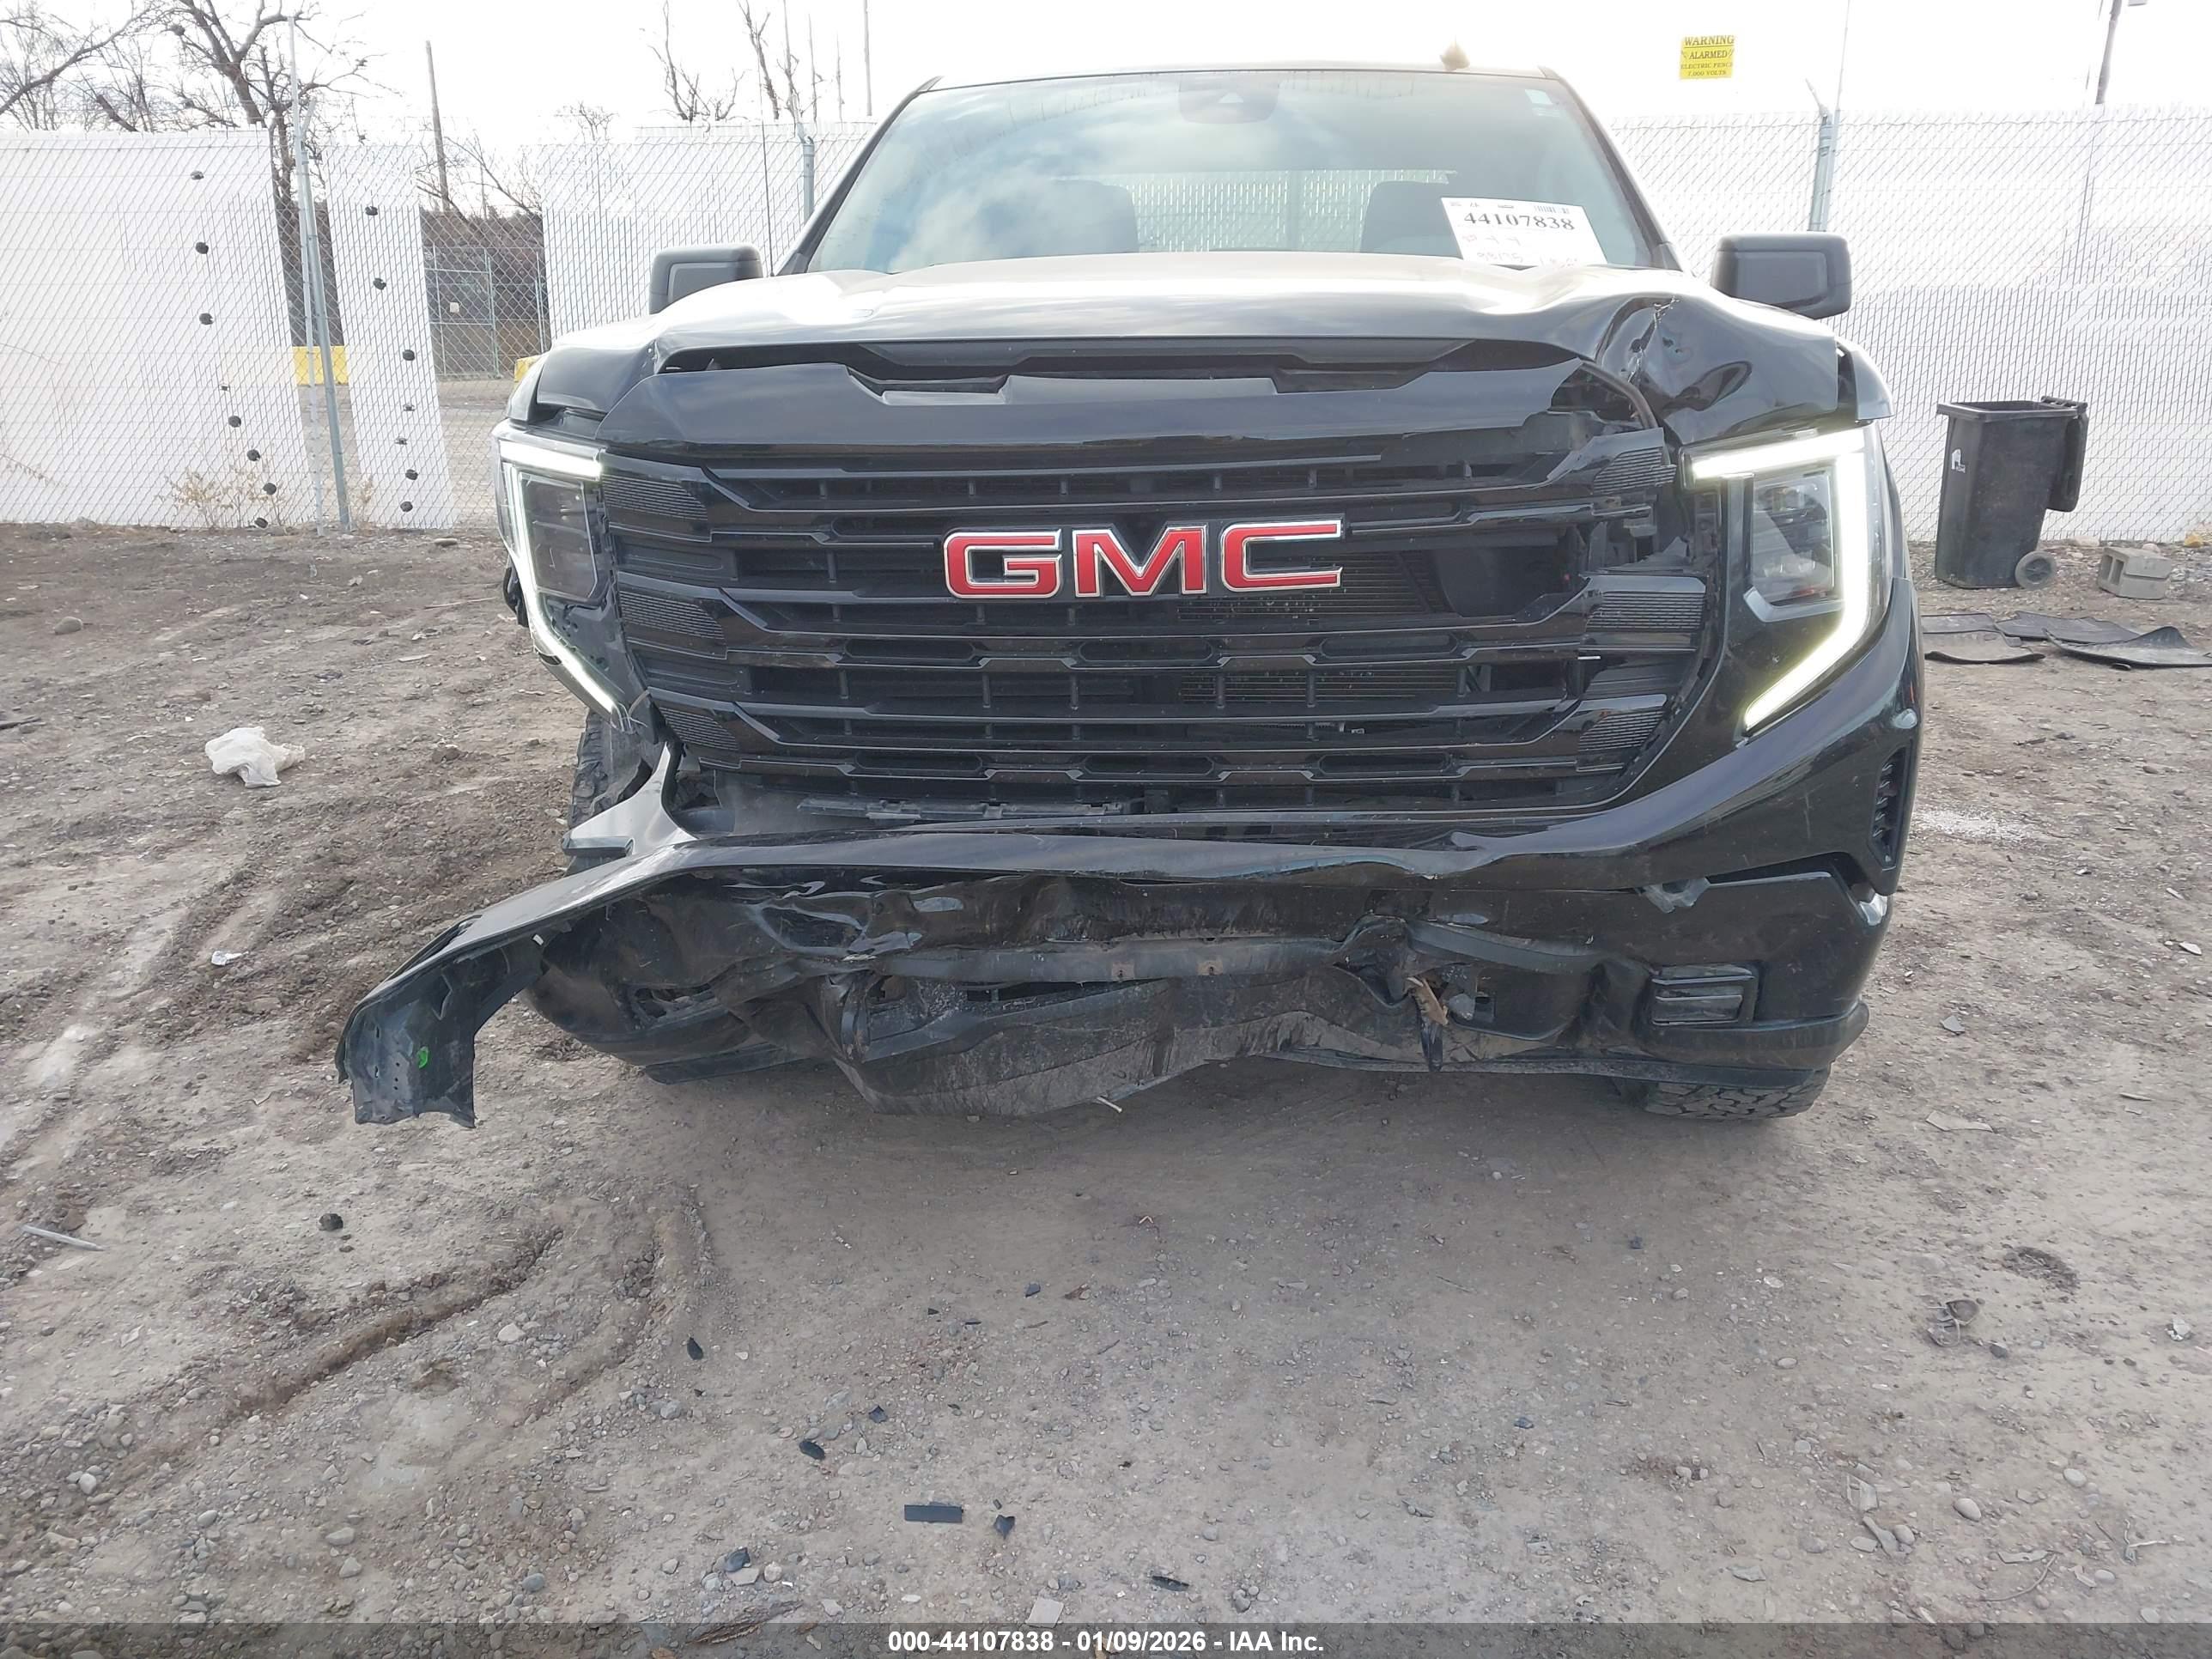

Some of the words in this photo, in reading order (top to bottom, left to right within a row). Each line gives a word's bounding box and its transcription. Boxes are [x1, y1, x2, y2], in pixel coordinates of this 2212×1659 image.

[1685, 35, 1735, 46] WARNING
[1689, 51, 1728, 59] ALARMED
[1463, 212, 1576, 231] 44107838
[943, 520, 1344, 599] GMC
